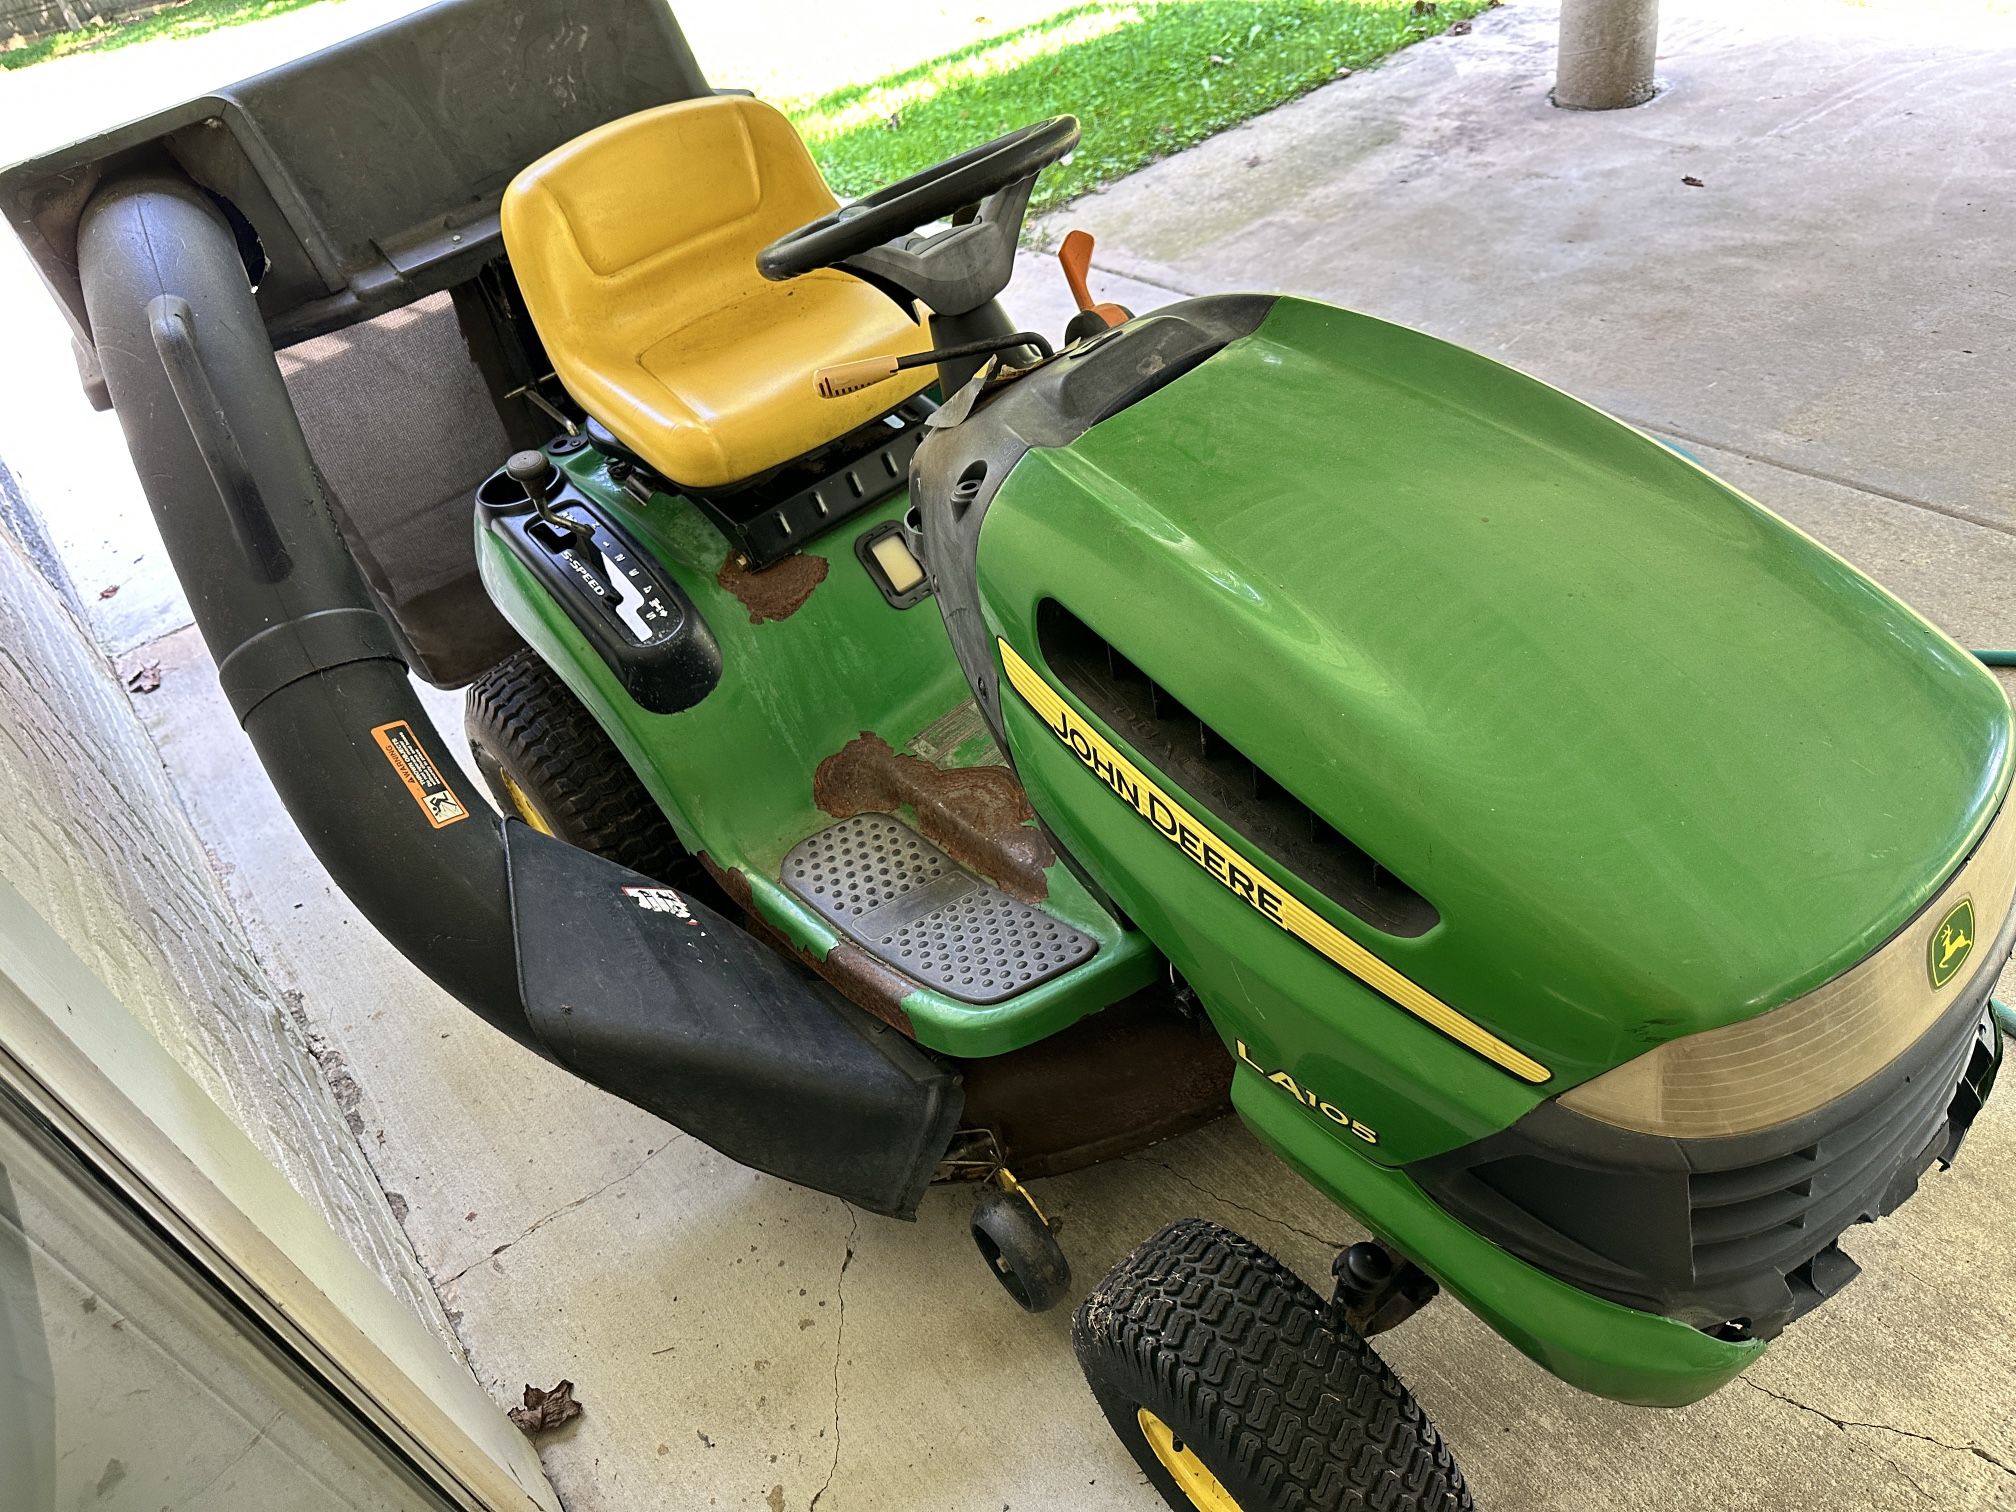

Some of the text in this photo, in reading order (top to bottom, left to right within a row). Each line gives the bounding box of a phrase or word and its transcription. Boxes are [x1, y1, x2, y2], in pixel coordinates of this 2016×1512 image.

[560, 551, 605, 596] 5-SPEED
[385, 744, 410, 778] WARNING
[391, 737, 410, 762] OBJECTS
[406, 762, 425, 785] THROWN
[1053, 711, 1284, 925] JOHN DEERE
[1236, 1039, 1377, 1144] LA105
